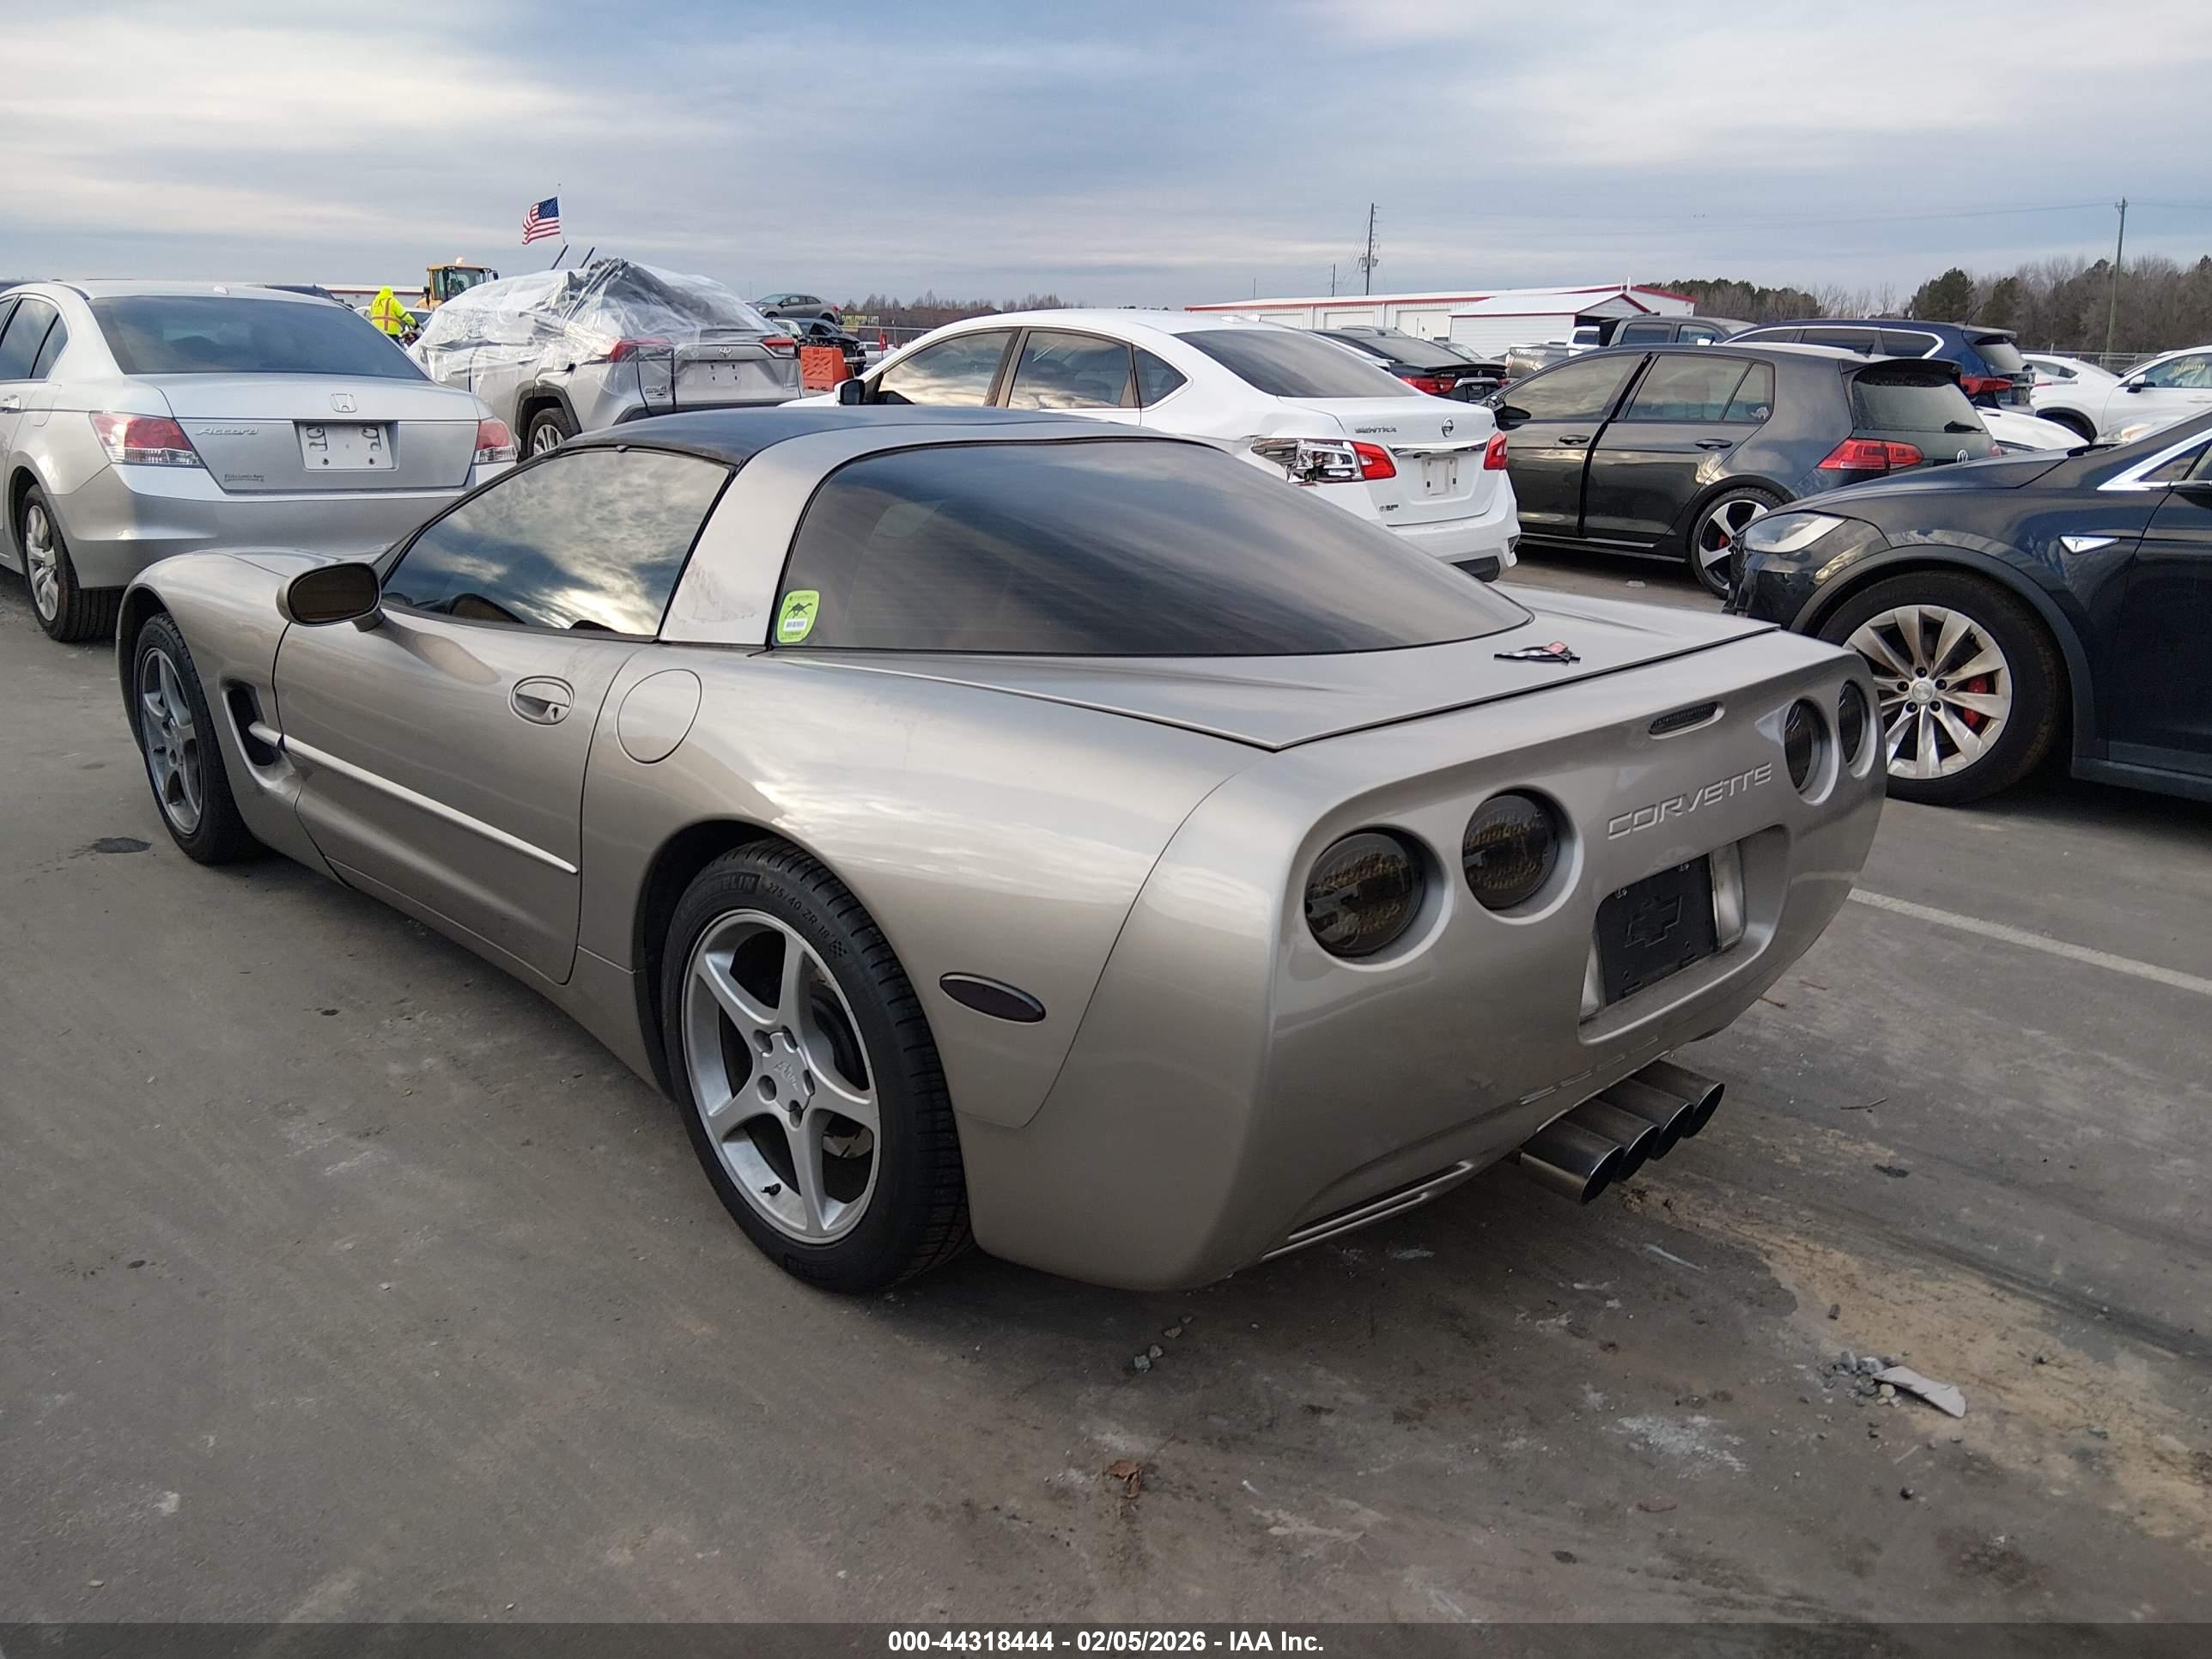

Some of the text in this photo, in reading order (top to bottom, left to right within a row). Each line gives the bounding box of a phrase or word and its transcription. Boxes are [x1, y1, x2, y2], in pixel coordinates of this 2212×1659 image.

[196, 427, 259, 435] Accord
[1607, 763, 1772, 841] CORVETTE
[767, 883, 802, 911] 275/40
[802, 908, 818, 926] ZR
